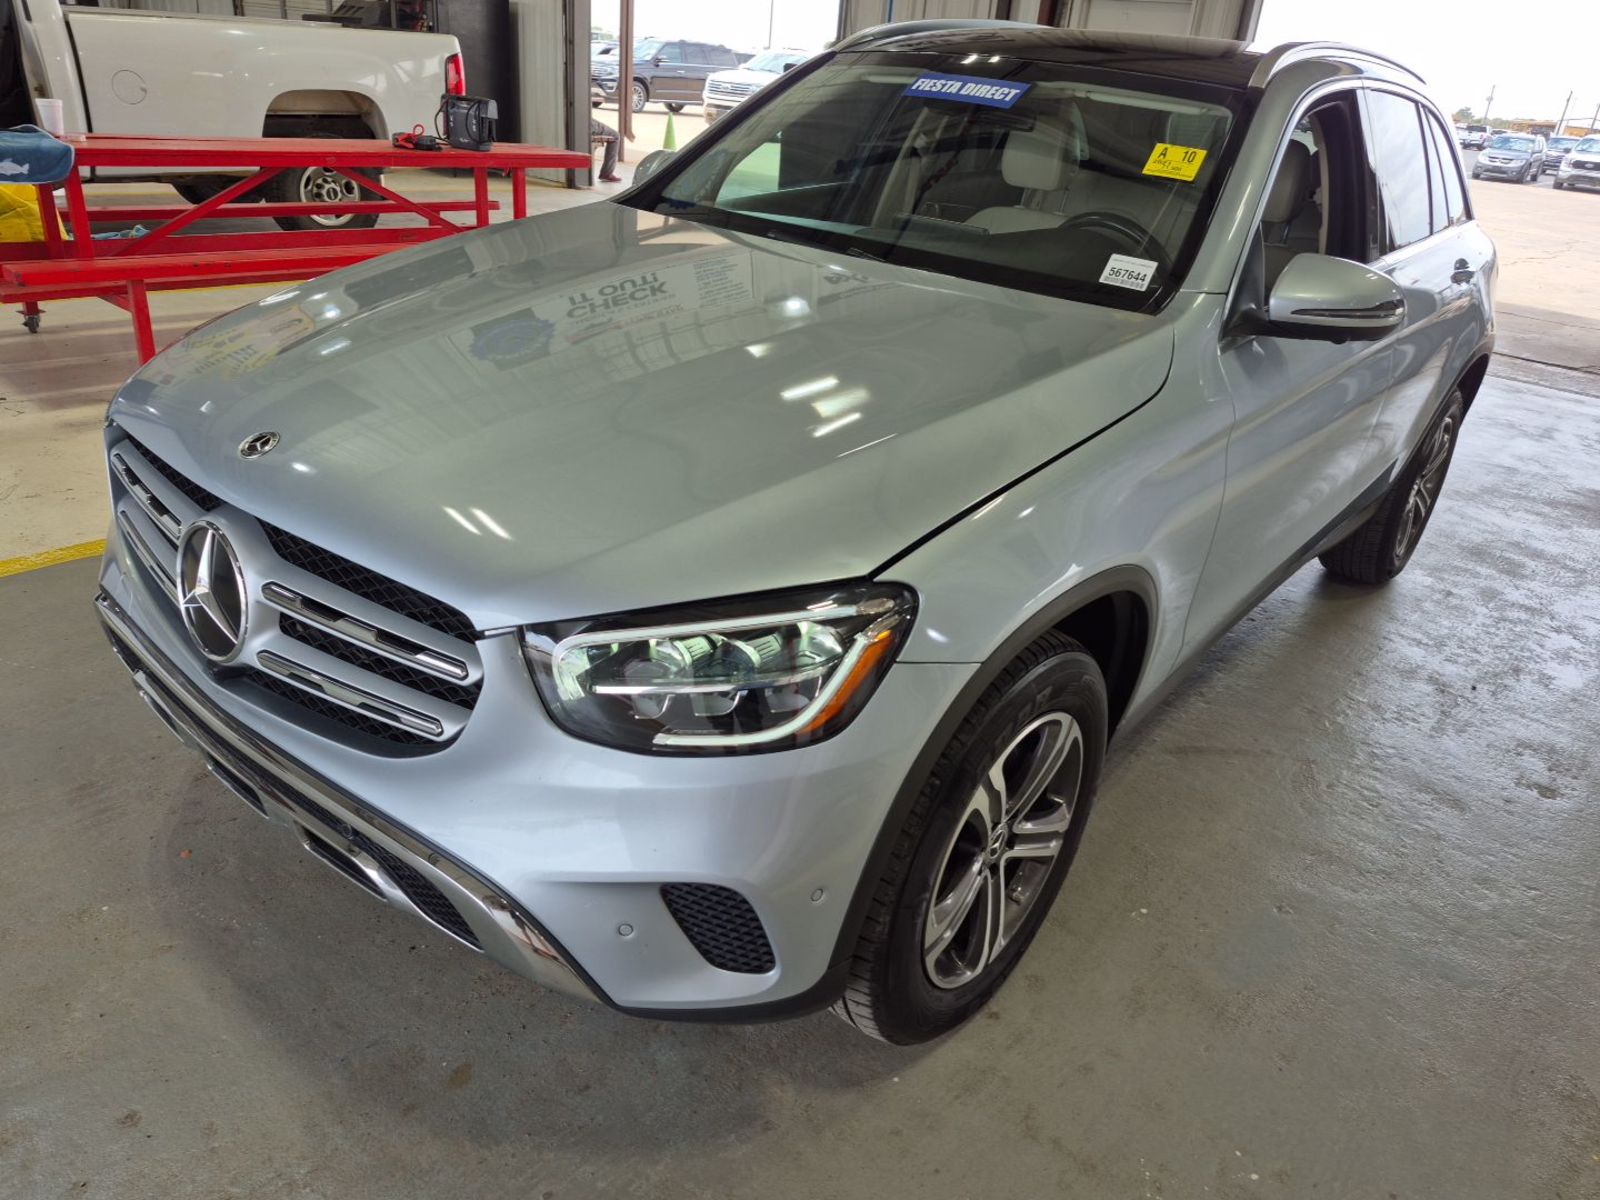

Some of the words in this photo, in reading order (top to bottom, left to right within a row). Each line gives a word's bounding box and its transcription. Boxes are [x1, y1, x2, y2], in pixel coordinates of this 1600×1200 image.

[911, 78, 963, 94] FIESTA
[959, 82, 1021, 101] DIRECT
[1157, 146, 1169, 160] A
[1183, 150, 1197, 163] 10
[1108, 266, 1147, 283] 567644
